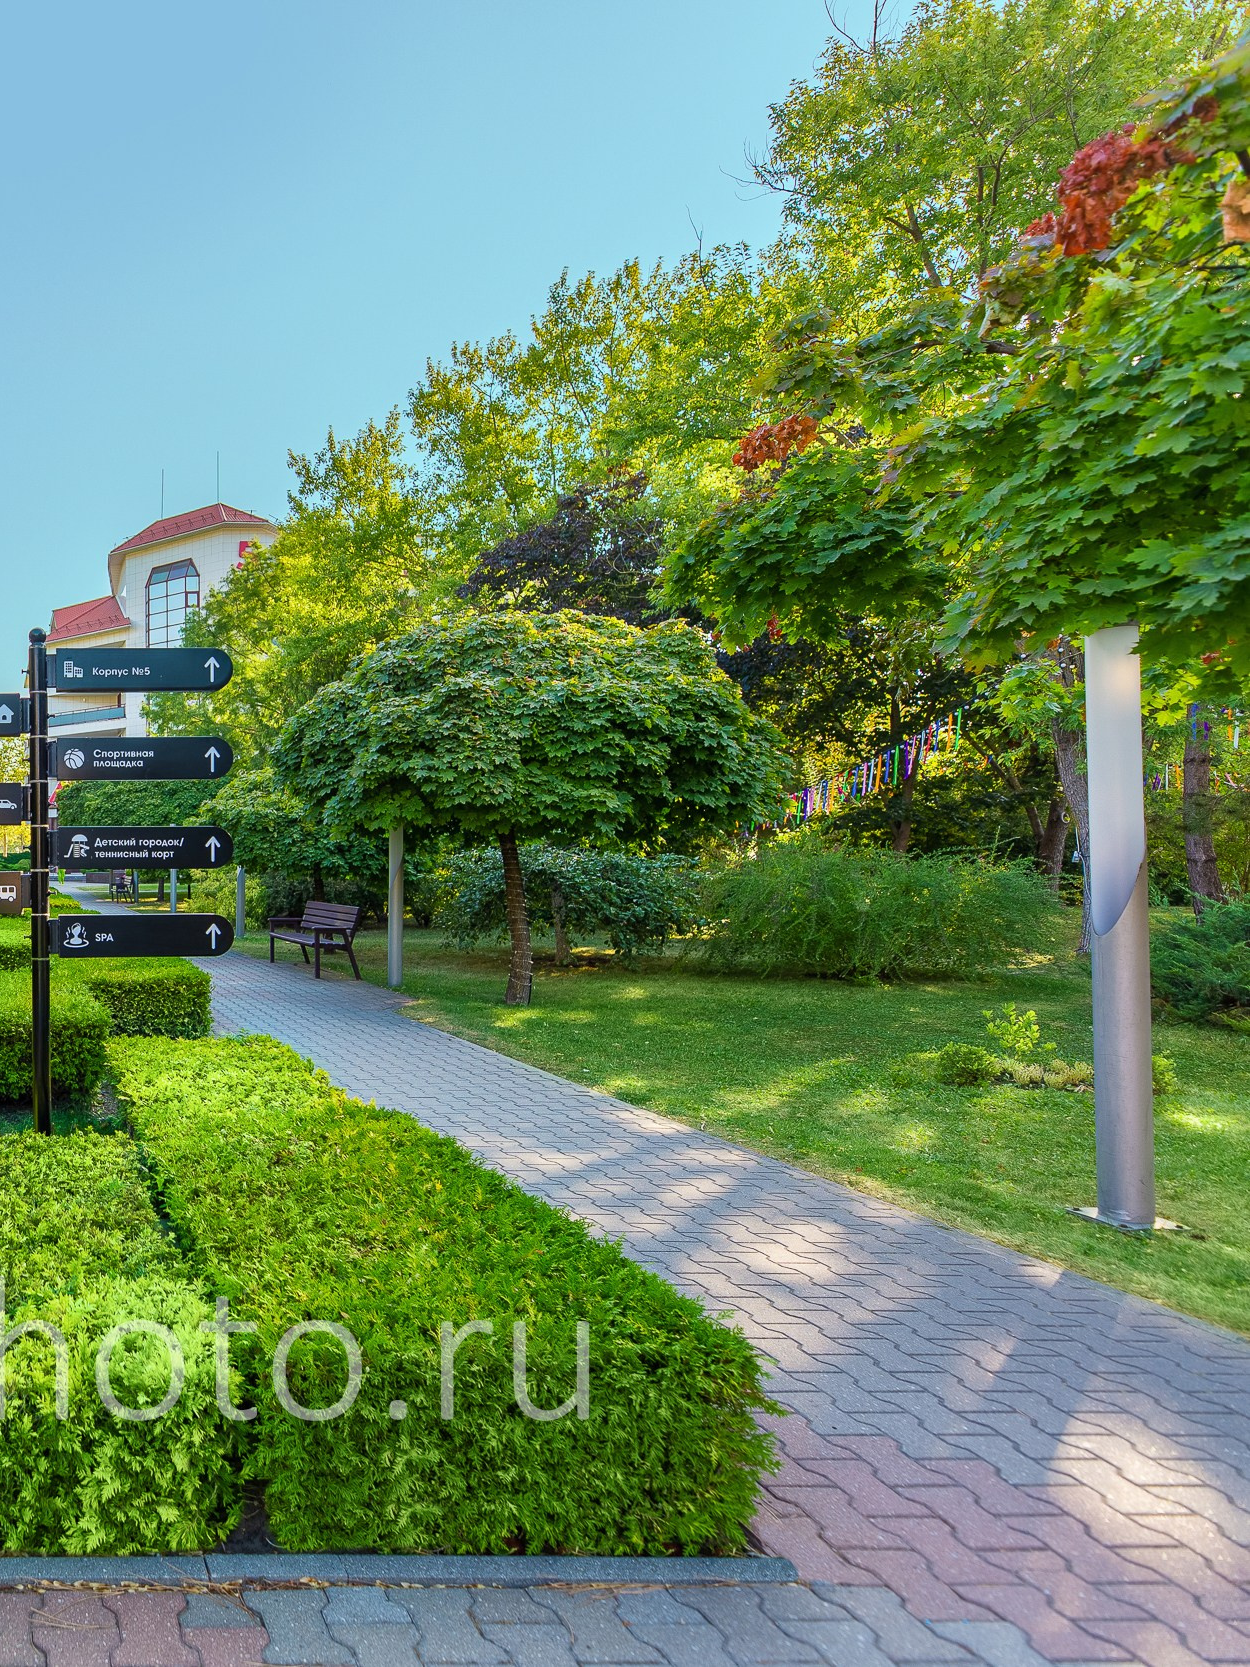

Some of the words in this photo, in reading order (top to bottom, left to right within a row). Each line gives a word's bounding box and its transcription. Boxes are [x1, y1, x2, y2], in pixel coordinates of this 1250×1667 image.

[92, 667, 129, 678] Корпус
[131, 667, 151, 676] №5
[93, 749, 154, 760] Спортивная
[93, 760, 144, 769] площадка
[94, 837, 136, 848] Детский
[138, 837, 185, 849] городок/
[94, 849, 149, 858] теннисный
[151, 850, 175, 860] корт
[95, 933, 114, 942] SPA
